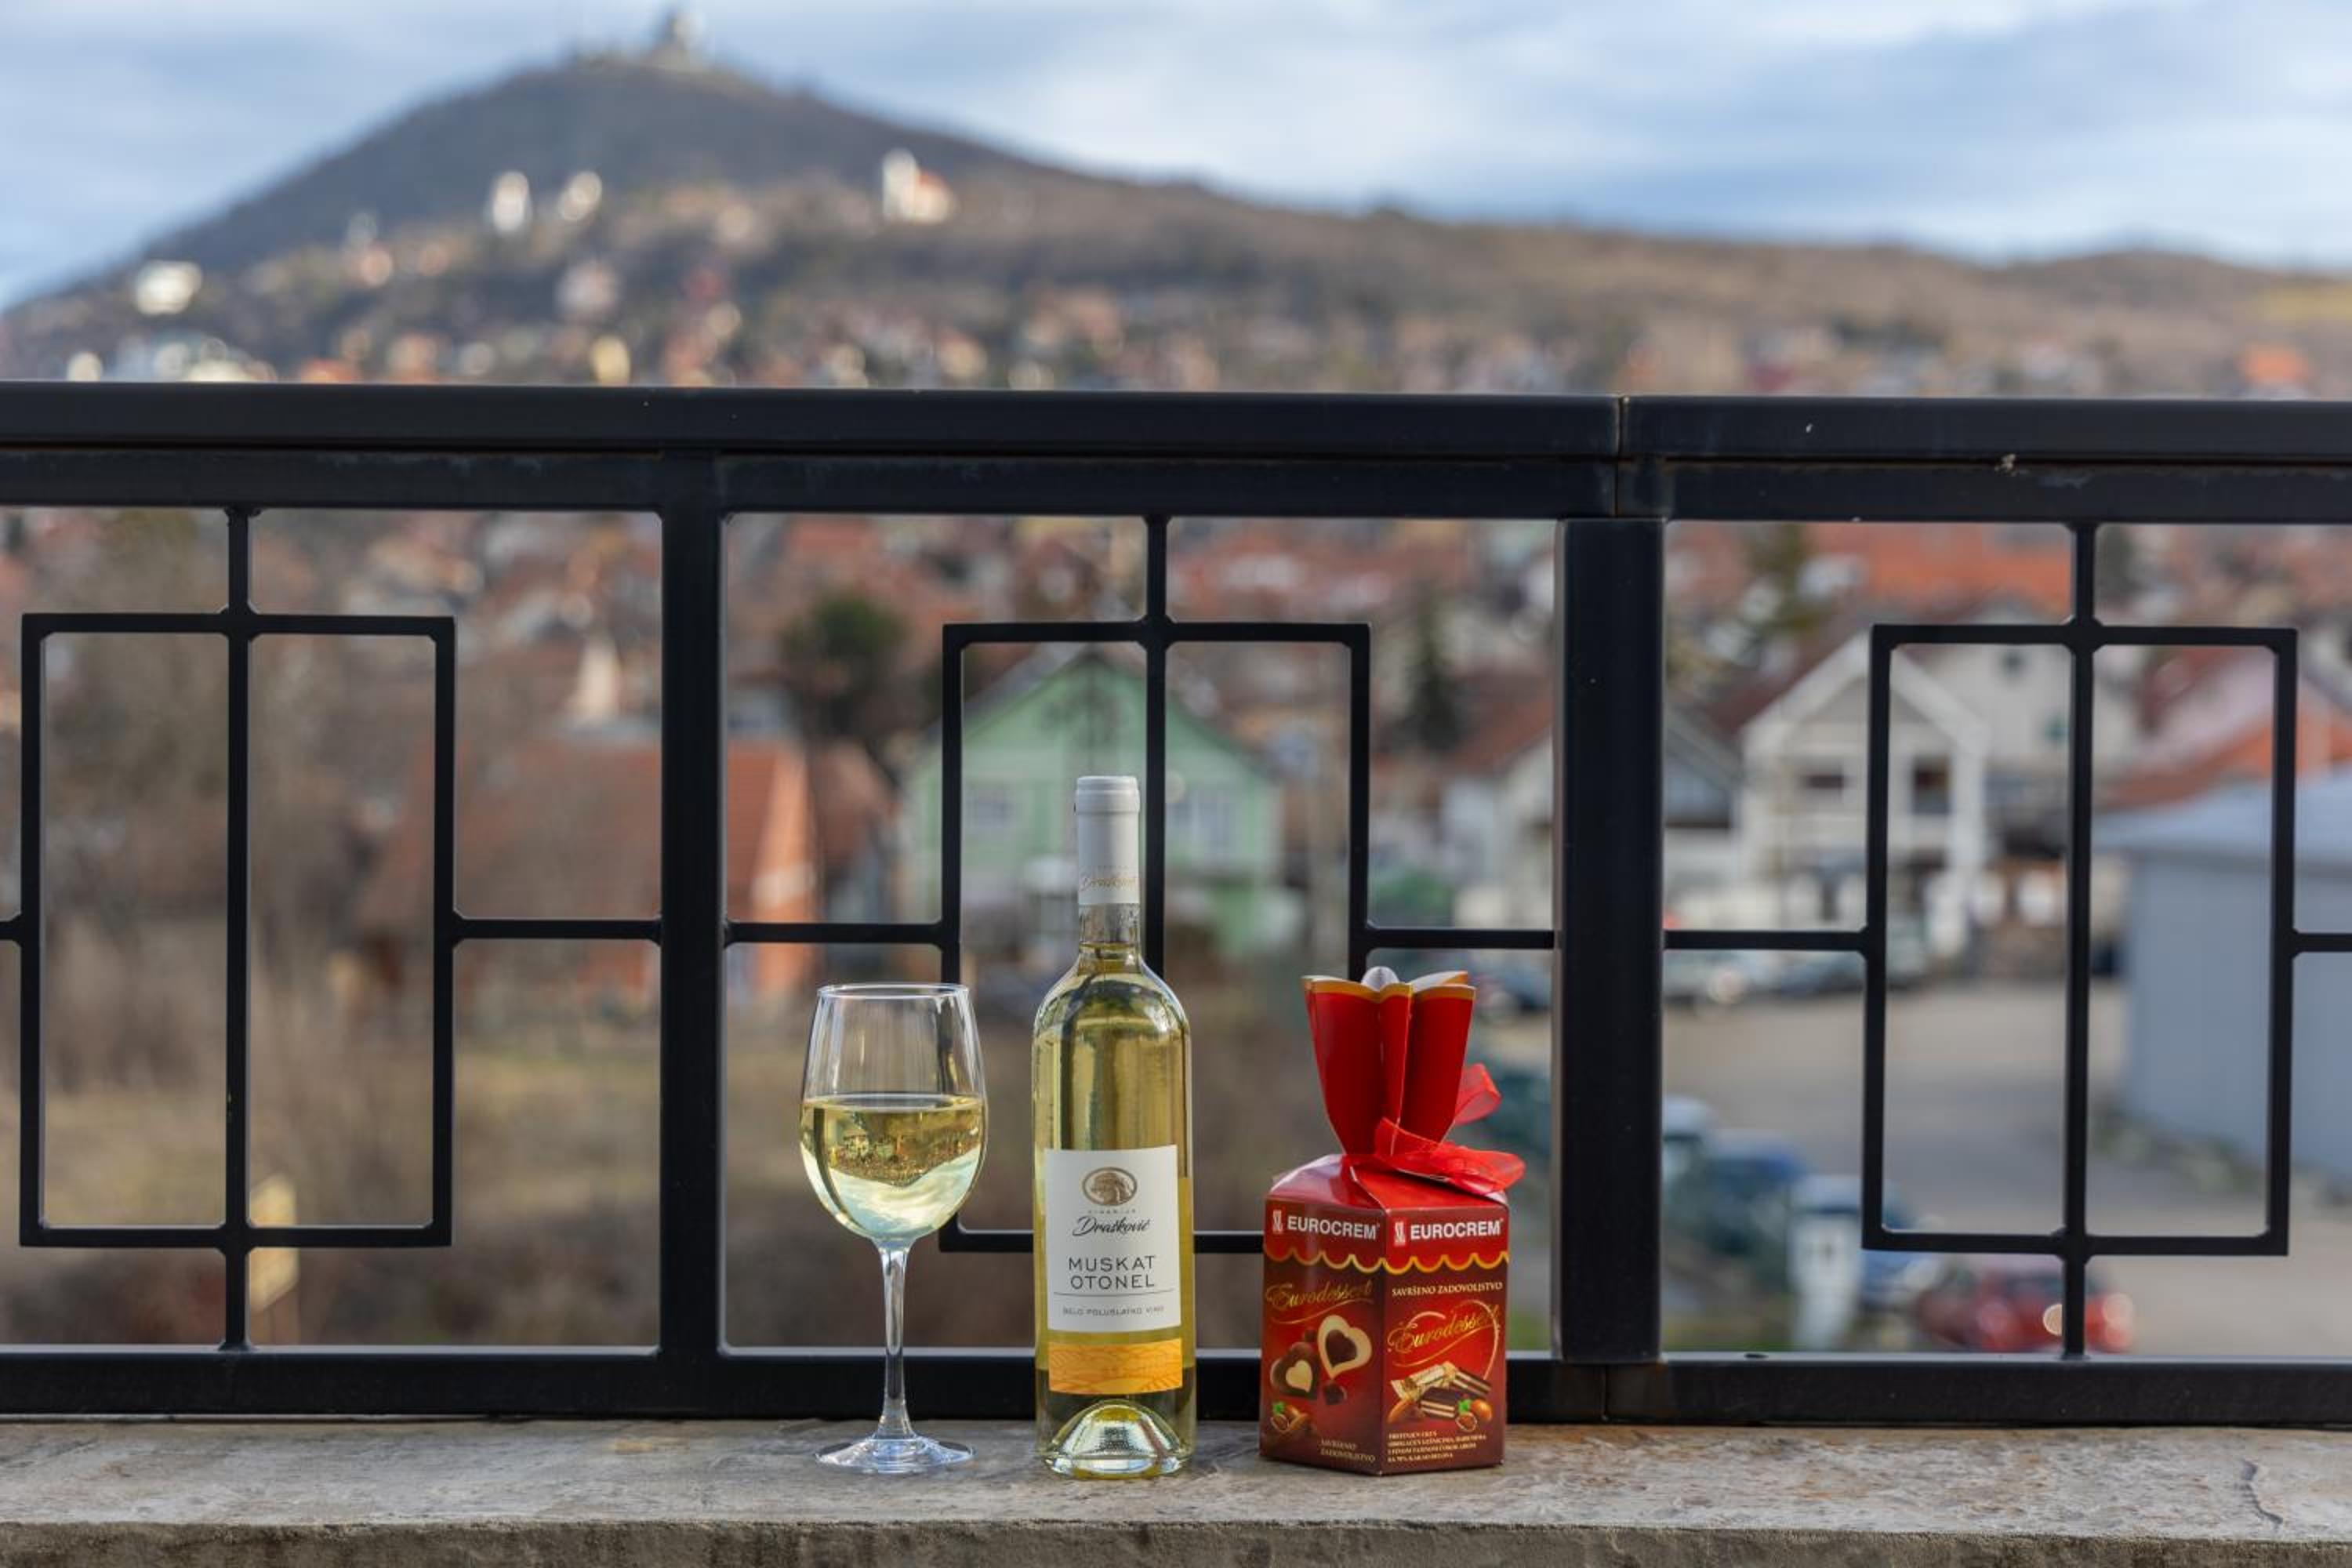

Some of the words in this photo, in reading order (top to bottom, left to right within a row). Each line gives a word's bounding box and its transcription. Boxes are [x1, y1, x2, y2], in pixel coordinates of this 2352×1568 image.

[1287, 1215, 1376, 1239] EUROCREM
[1410, 1220, 1501, 1240] EUROCREM
[1069, 1255, 1156, 1272] MUSKAT
[1070, 1274, 1155, 1290] OTONEL
